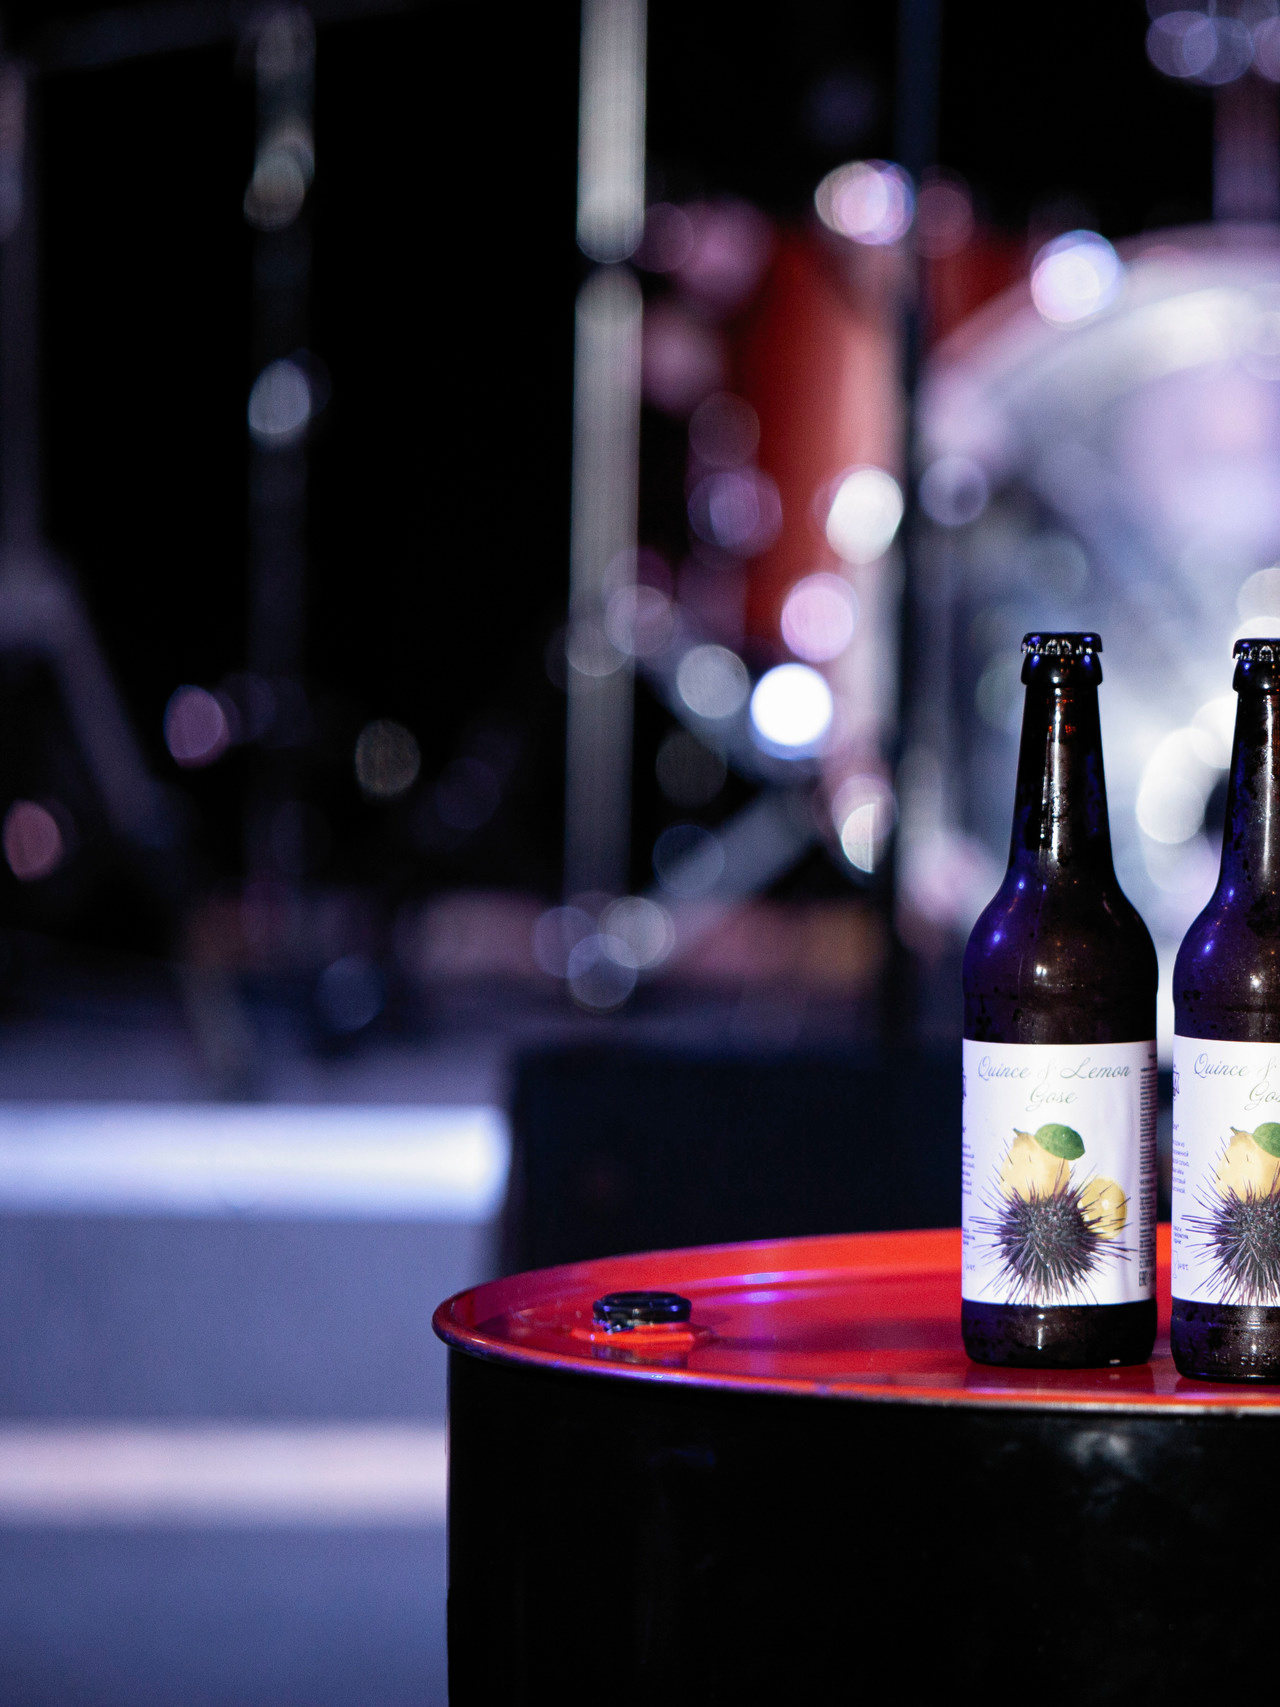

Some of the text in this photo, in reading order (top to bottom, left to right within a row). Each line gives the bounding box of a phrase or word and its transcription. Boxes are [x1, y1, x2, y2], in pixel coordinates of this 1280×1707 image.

[978, 1055, 1031, 1081] Quince
[1060, 1056, 1132, 1079] Lemon
[1194, 1053, 1249, 1078] Quince
[1025, 1082, 1078, 1112] Gose
